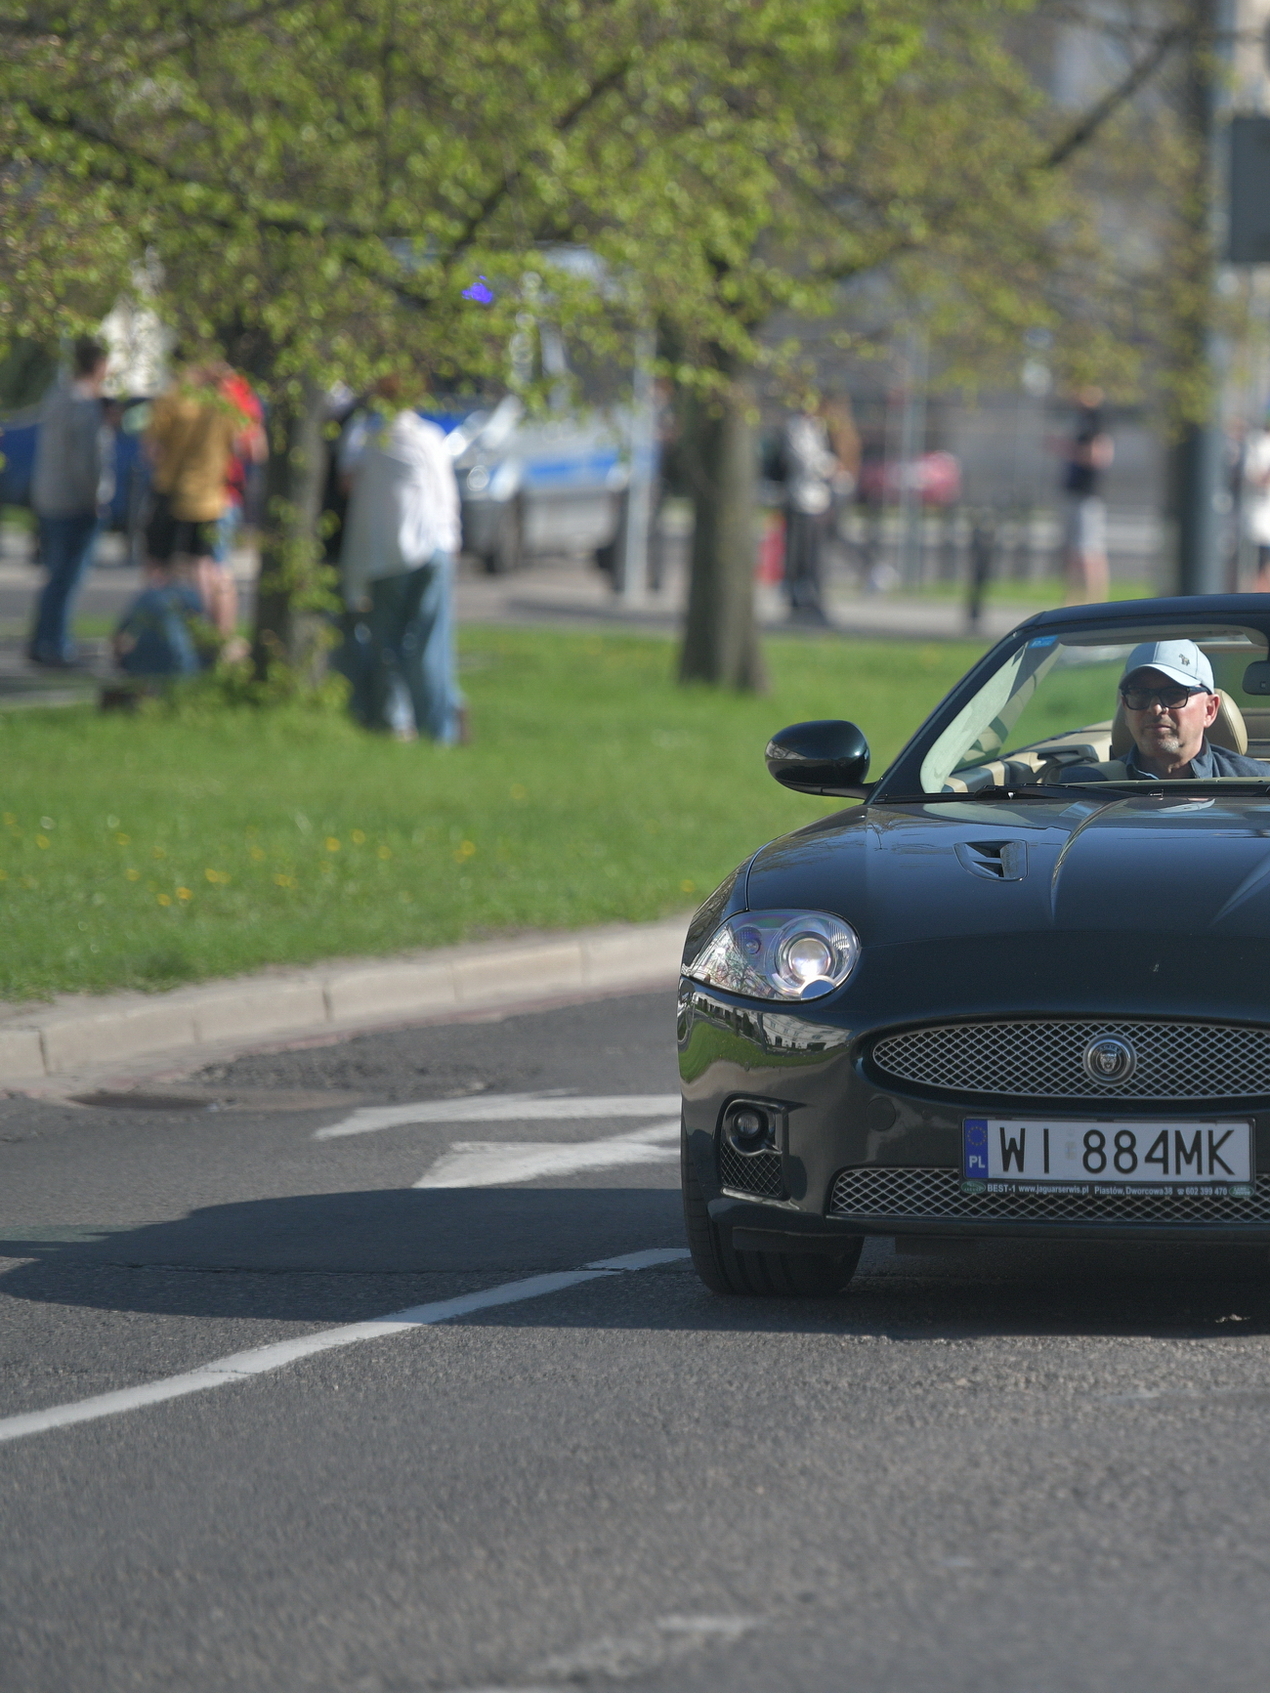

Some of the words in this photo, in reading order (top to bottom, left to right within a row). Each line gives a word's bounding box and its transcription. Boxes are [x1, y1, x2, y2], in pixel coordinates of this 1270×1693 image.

[999, 1127, 1049, 1174] WI
[1082, 1129, 1235, 1175] 884MK
[969, 1155, 986, 1169] PL
[987, 1183, 1016, 1193] BEST-1
[1018, 1184, 1089, 1195] www.jaguarserwis.pl
[1185, 1187, 1199, 1196] 602
